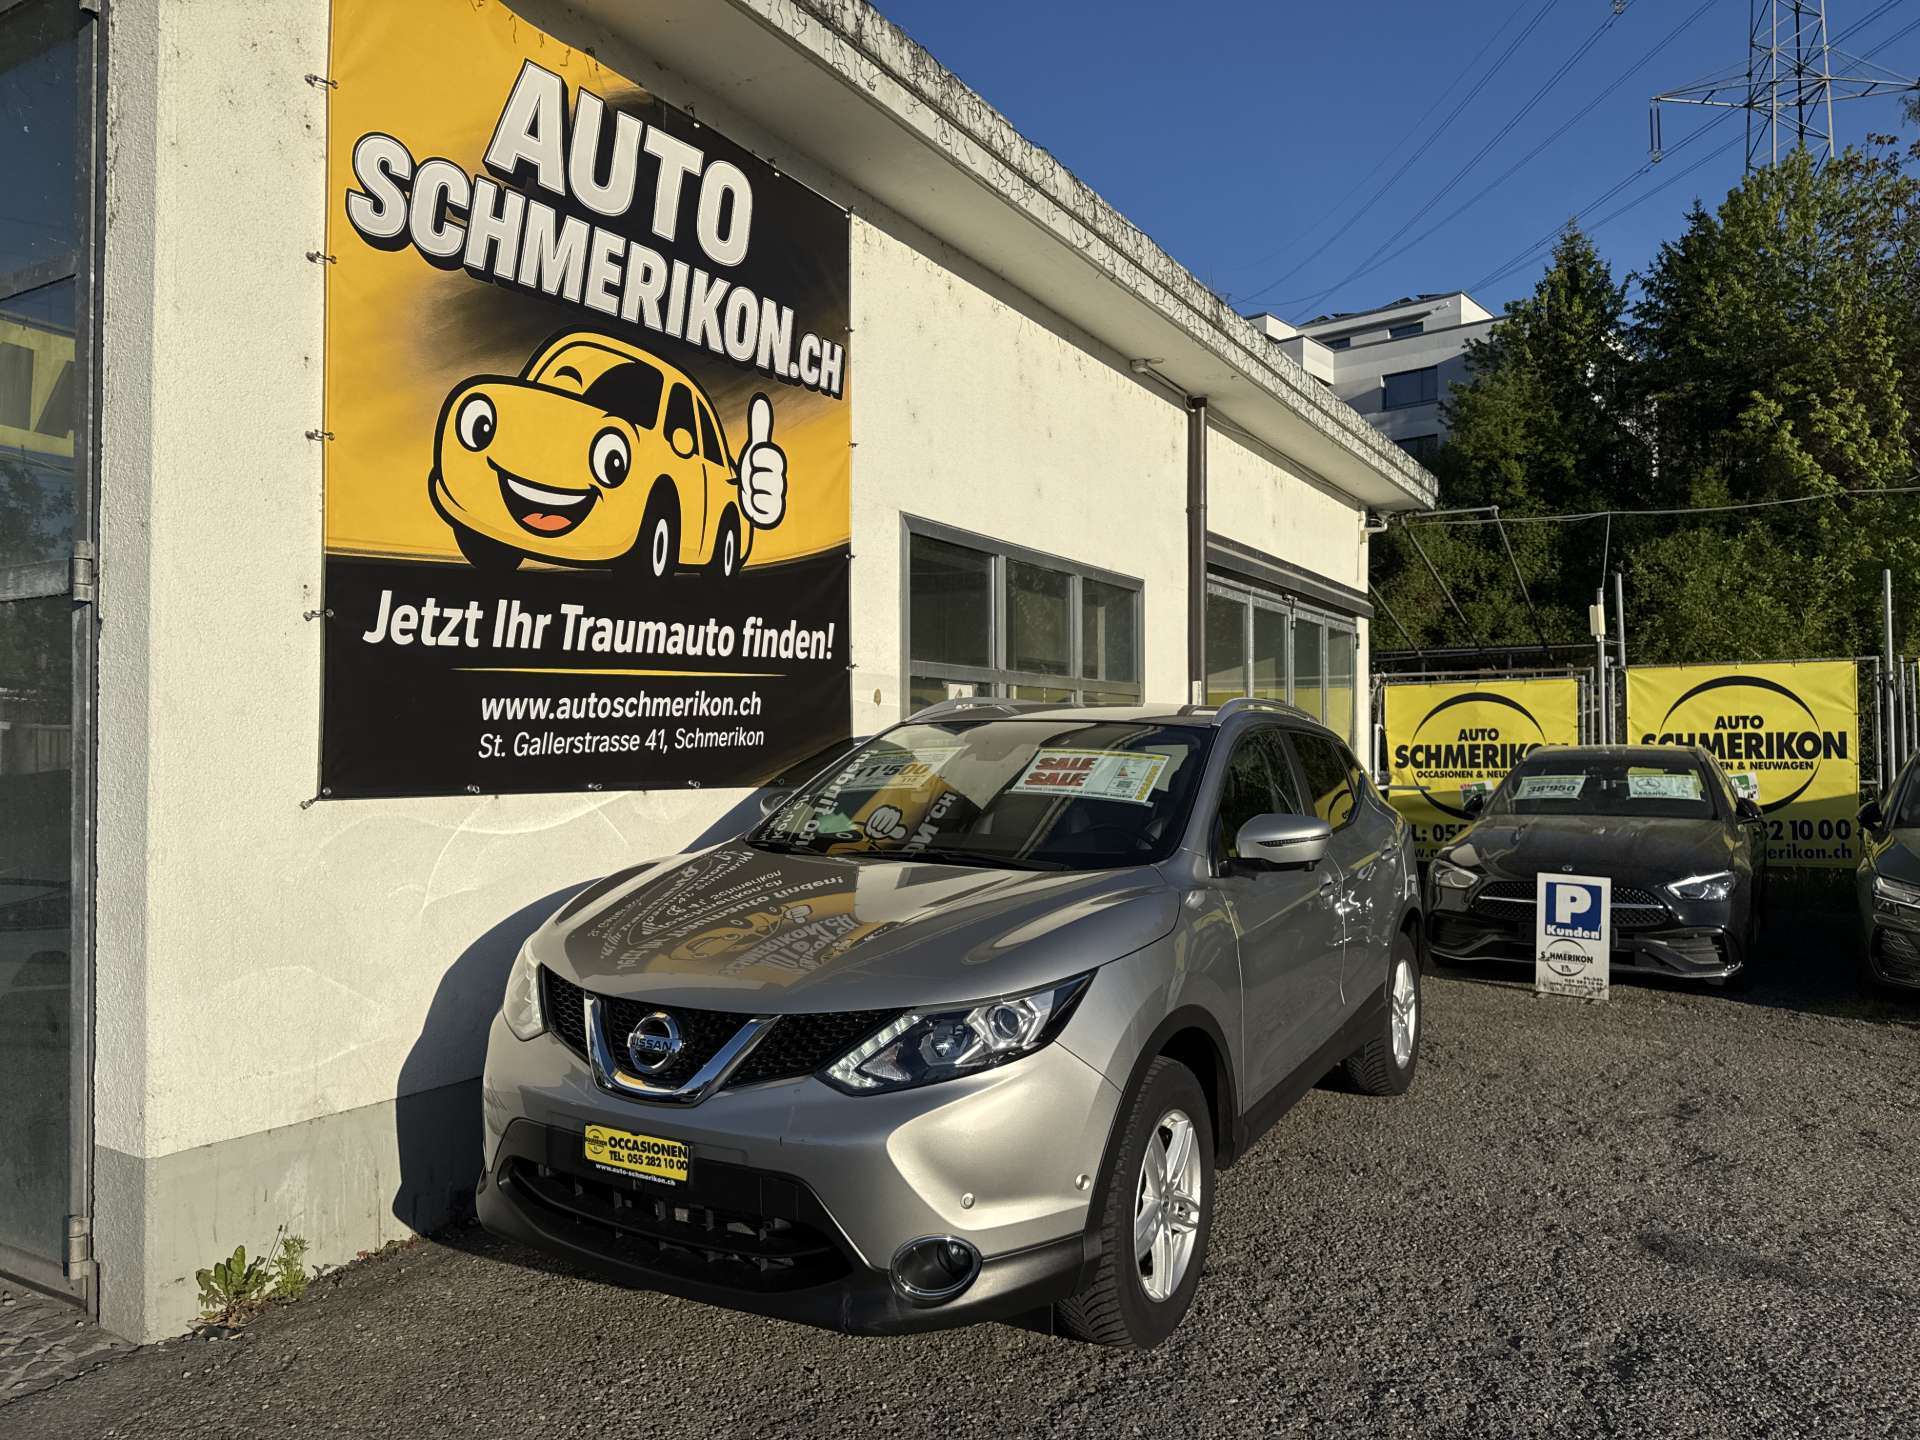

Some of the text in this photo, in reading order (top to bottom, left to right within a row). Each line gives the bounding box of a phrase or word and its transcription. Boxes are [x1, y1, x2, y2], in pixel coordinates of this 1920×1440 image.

[487, 61, 753, 266] AUTO
[347, 133, 844, 394] SCHMERIKON.CH
[363, 590, 835, 660] Jetzt Ihr Traumauto finden!
[481, 690, 762, 721] www.autoschmerikon.ch
[1714, 715, 1764, 730] AUTO
[478, 727, 765, 758] St. Gallerstrasse 41, Schmerikon
[1457, 728, 1499, 742] AUTO
[1035, 757, 1098, 770] SALE
[1394, 743, 1568, 769] SCHMERIK
[1737, 761, 1745, 770] &
[1750, 761, 1813, 770] NEUWAGEN
[1024, 772, 1089, 786] SALE
[1416, 770, 1473, 779] OCCASIONEN
[1476, 770, 1484, 778] &
[1789, 820, 1813, 840] 10
[1556, 884, 1592, 924] P
[1546, 924, 1600, 939] Kunden
[1540, 951, 1594, 964] SHMERIKON
[608, 1136, 688, 1159] OCCASIONEN
[609, 1150, 688, 1171] TEL: 055 282 10 00
[595, 1163, 676, 1187] www.auto-schmerikon.ch
